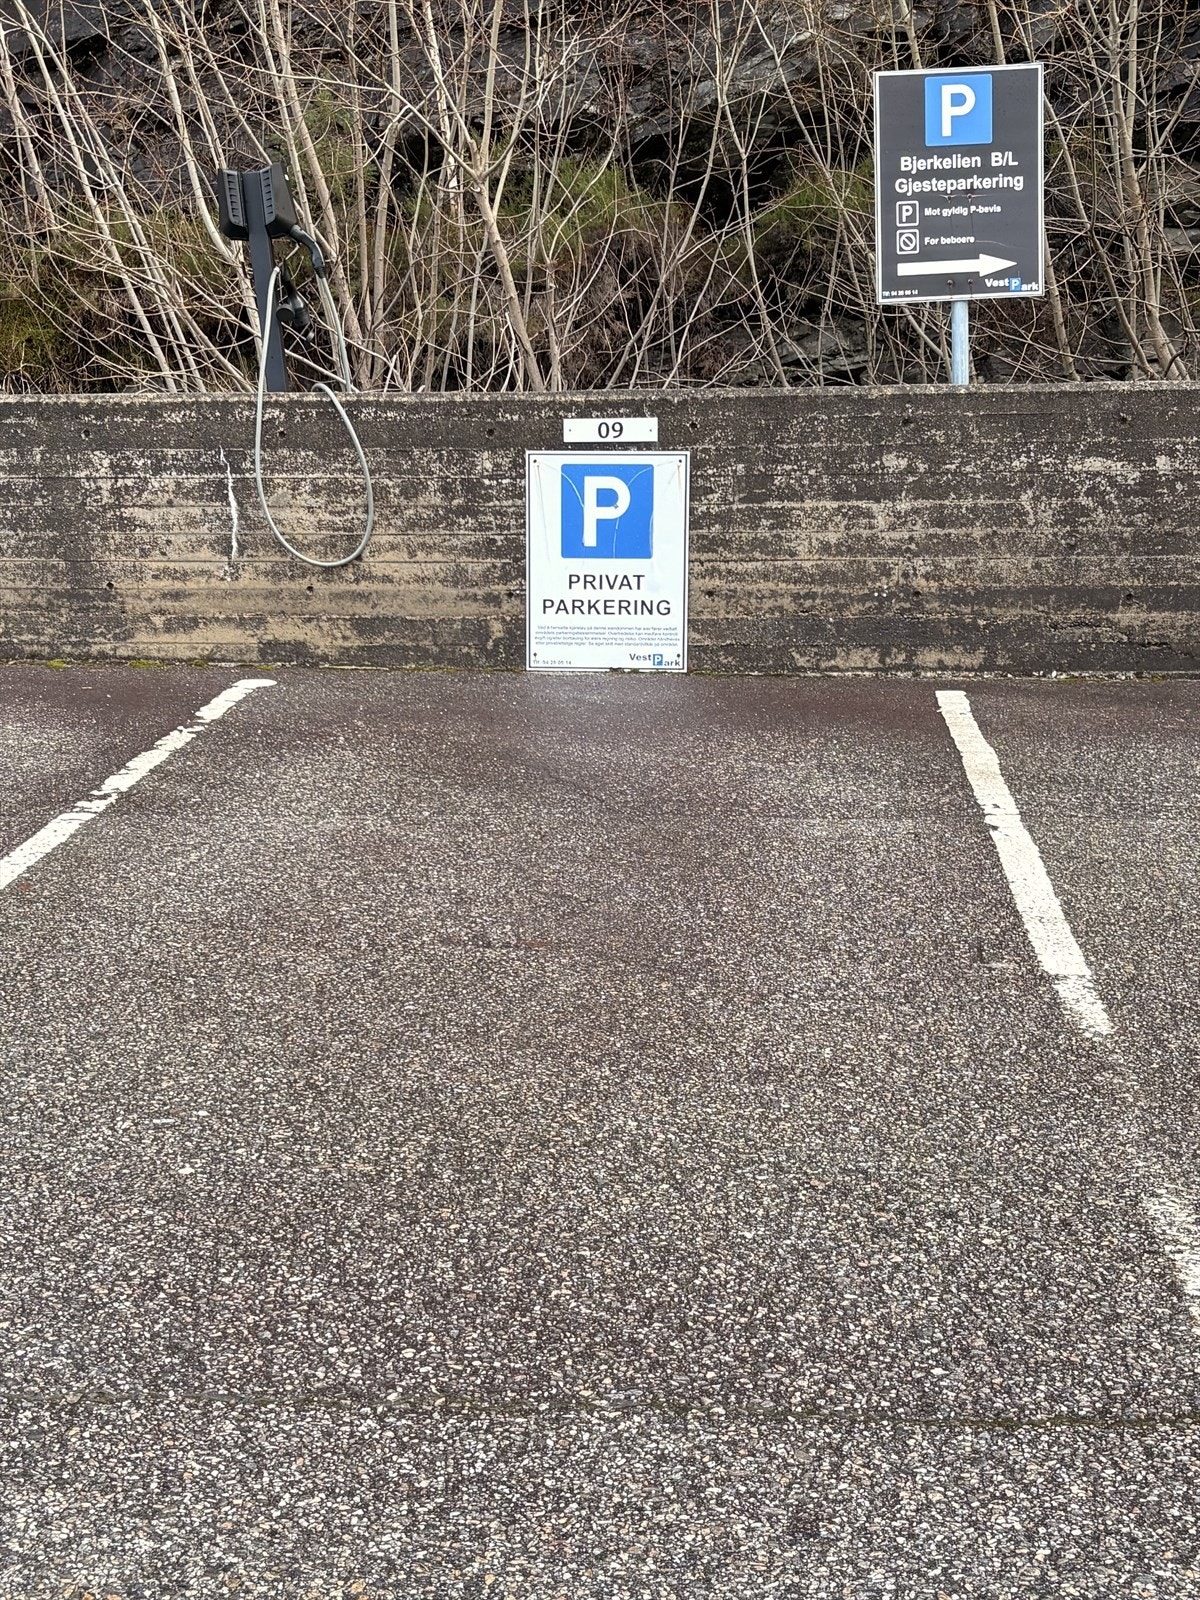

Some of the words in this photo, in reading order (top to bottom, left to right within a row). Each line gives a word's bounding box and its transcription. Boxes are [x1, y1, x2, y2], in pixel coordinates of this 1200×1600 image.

[941, 83, 976, 137] P
[900, 153, 981, 174] Bjerkelien
[991, 151, 1018, 167] B/L
[895, 174, 1024, 196] Gjesteparkering
[902, 206, 913, 222] P
[924, 207, 941, 216] Mot
[942, 205, 968, 218] gyldig
[970, 204, 1001, 214] P-bevis
[924, 237, 940, 245] For
[940, 235, 975, 245] beboere
[597, 421, 624, 438] 09
[583, 475, 631, 547] P
[568, 574, 645, 590] PRIVAT
[543, 599, 671, 616] PARKERING
